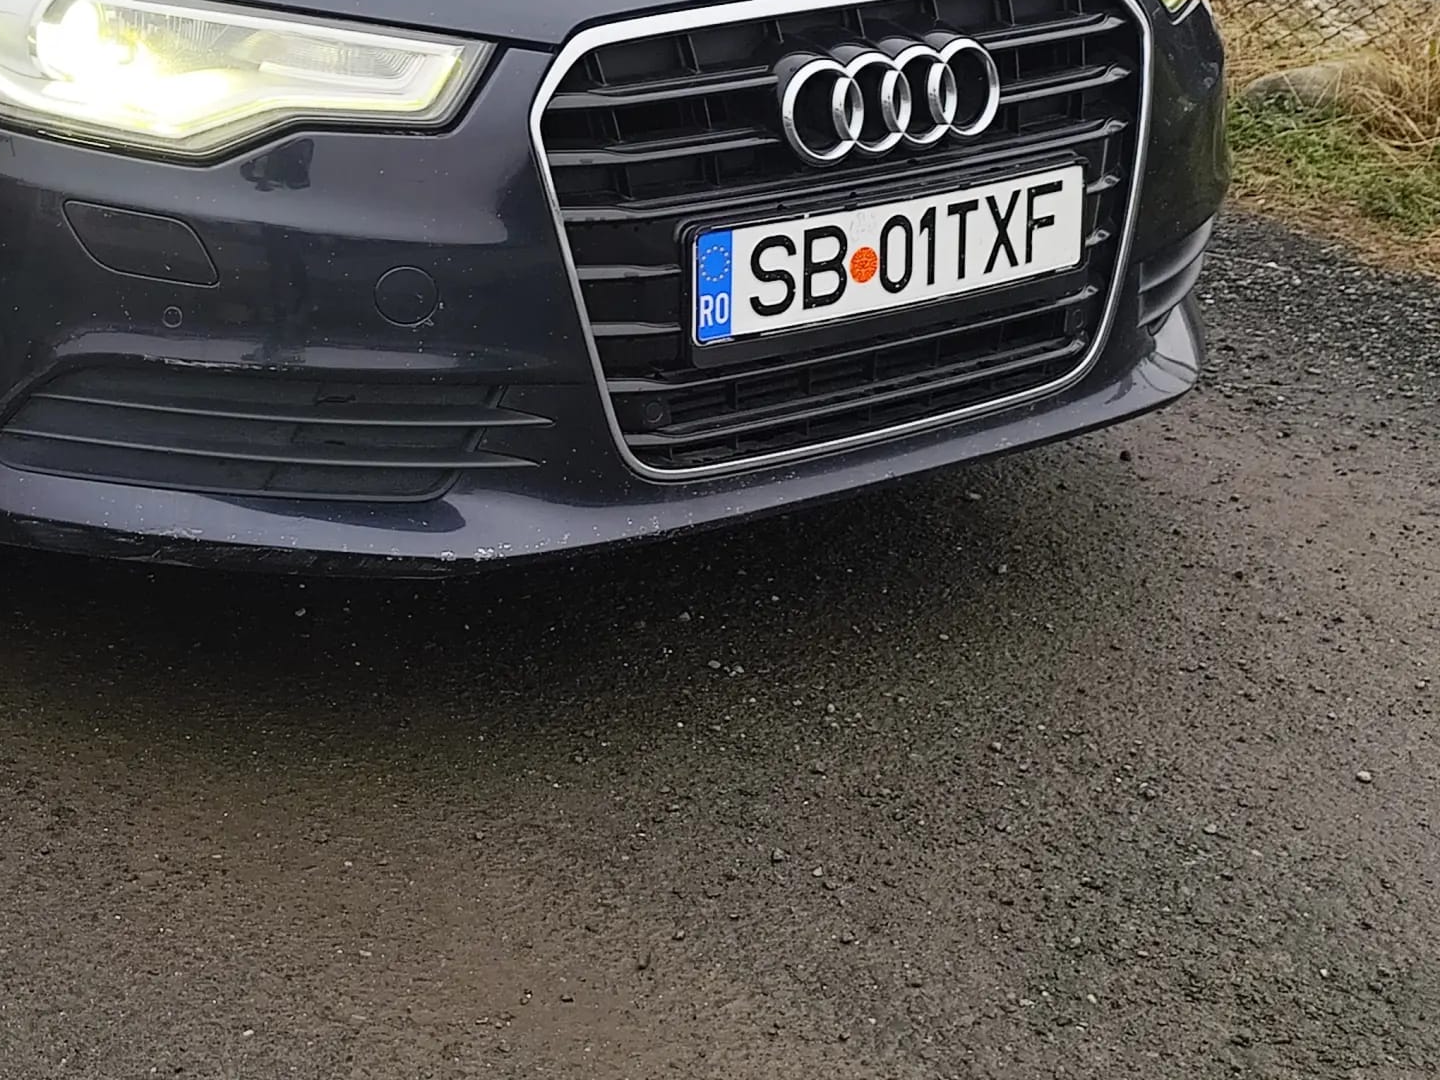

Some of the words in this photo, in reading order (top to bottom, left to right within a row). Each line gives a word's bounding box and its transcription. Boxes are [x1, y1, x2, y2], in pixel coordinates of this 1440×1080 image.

[749, 225, 848, 317] SB
[878, 180, 1063, 295] 01TXF
[699, 293, 729, 327] RO
